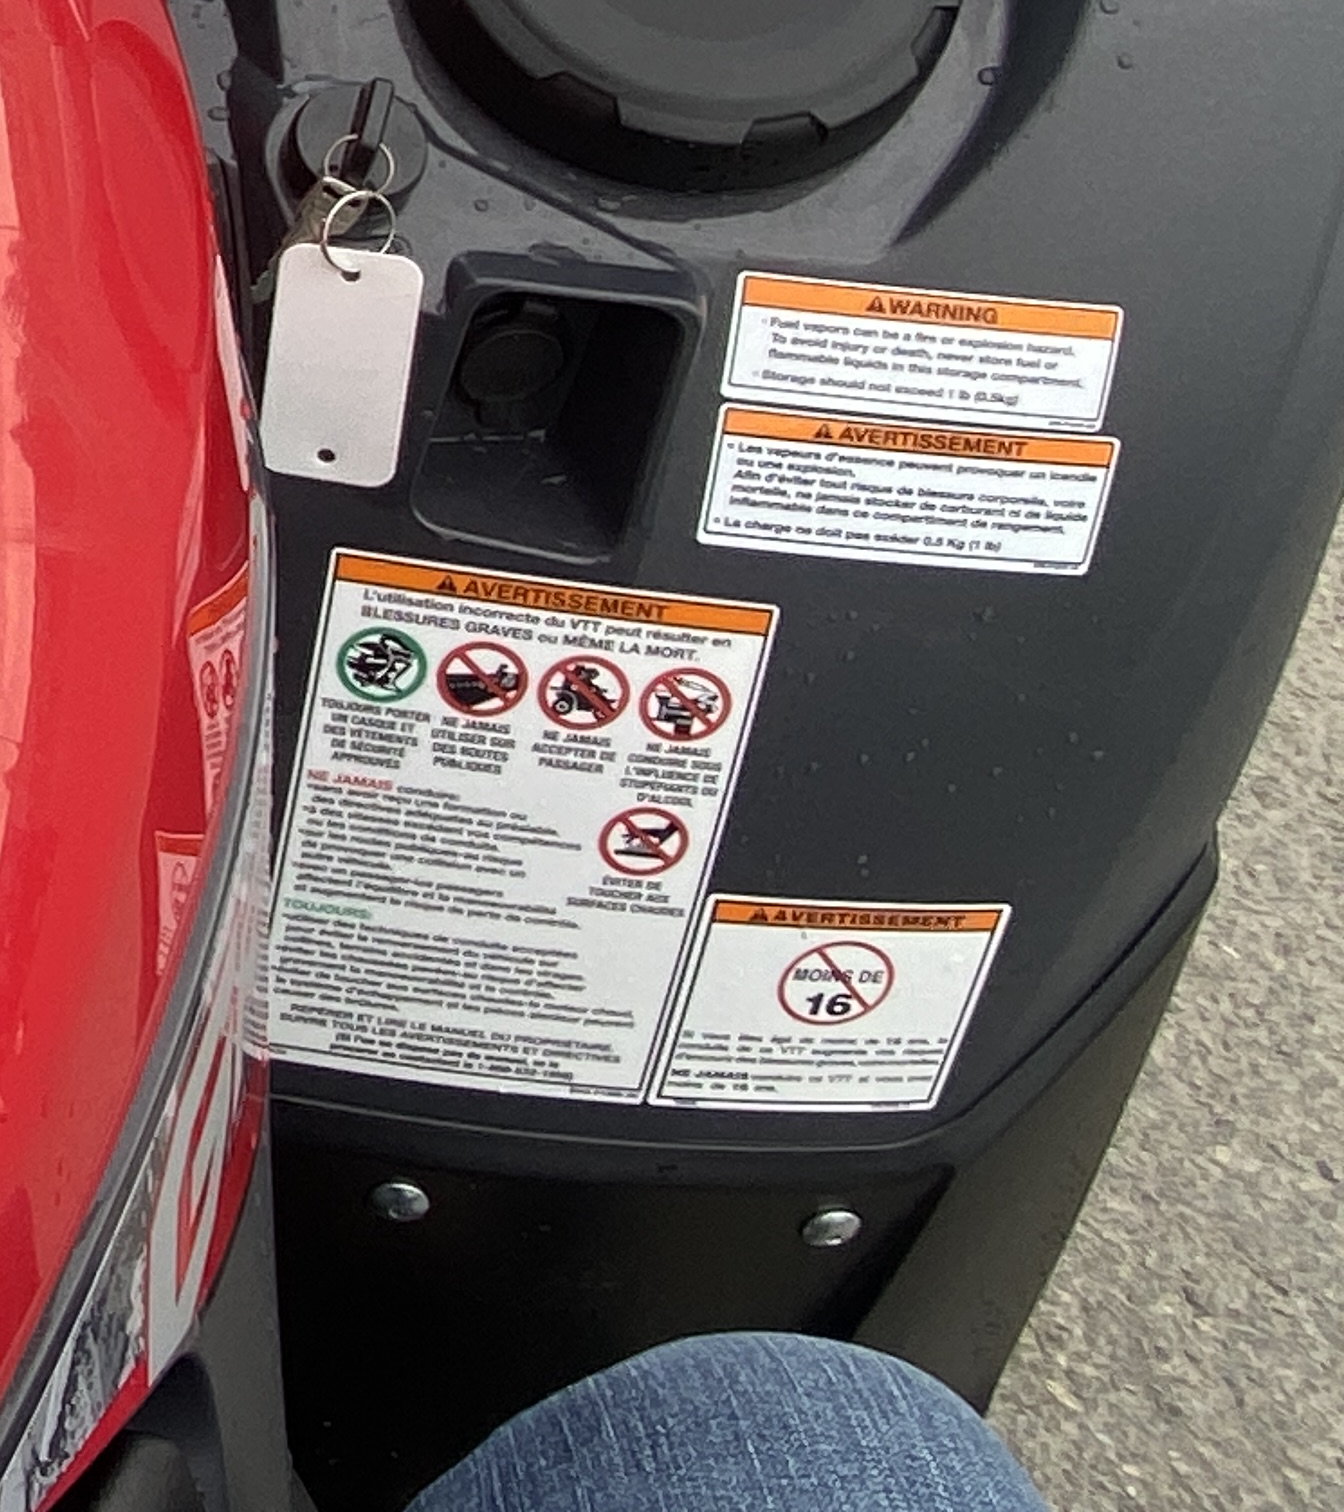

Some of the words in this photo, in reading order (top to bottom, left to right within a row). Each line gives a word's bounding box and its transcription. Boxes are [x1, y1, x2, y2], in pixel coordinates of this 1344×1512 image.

[889, 298, 1001, 324] WARNING
[838, 425, 1029, 457] AVERTISSEMENT
[462, 578, 670, 622] AVERTISSEMENT
[360, 604, 461, 630] BLESSURES
[463, 619, 534, 641] GRAVES
[537, 630, 560, 644] ou
[619, 640, 642, 655] LA
[362, 588, 455, 613] L'utilisation
[458, 601, 542, 625] incorrecte
[545, 613, 567, 628] du
[568, 617, 603, 633] VTT
[604, 621, 642, 640] peut
[710, 636, 732, 649] en
[772, 908, 967, 930] AVERTISSEMENT
[792, 967, 855, 983] MOINS
[856, 969, 886, 984] DE
[801, 992, 856, 1016] 16
